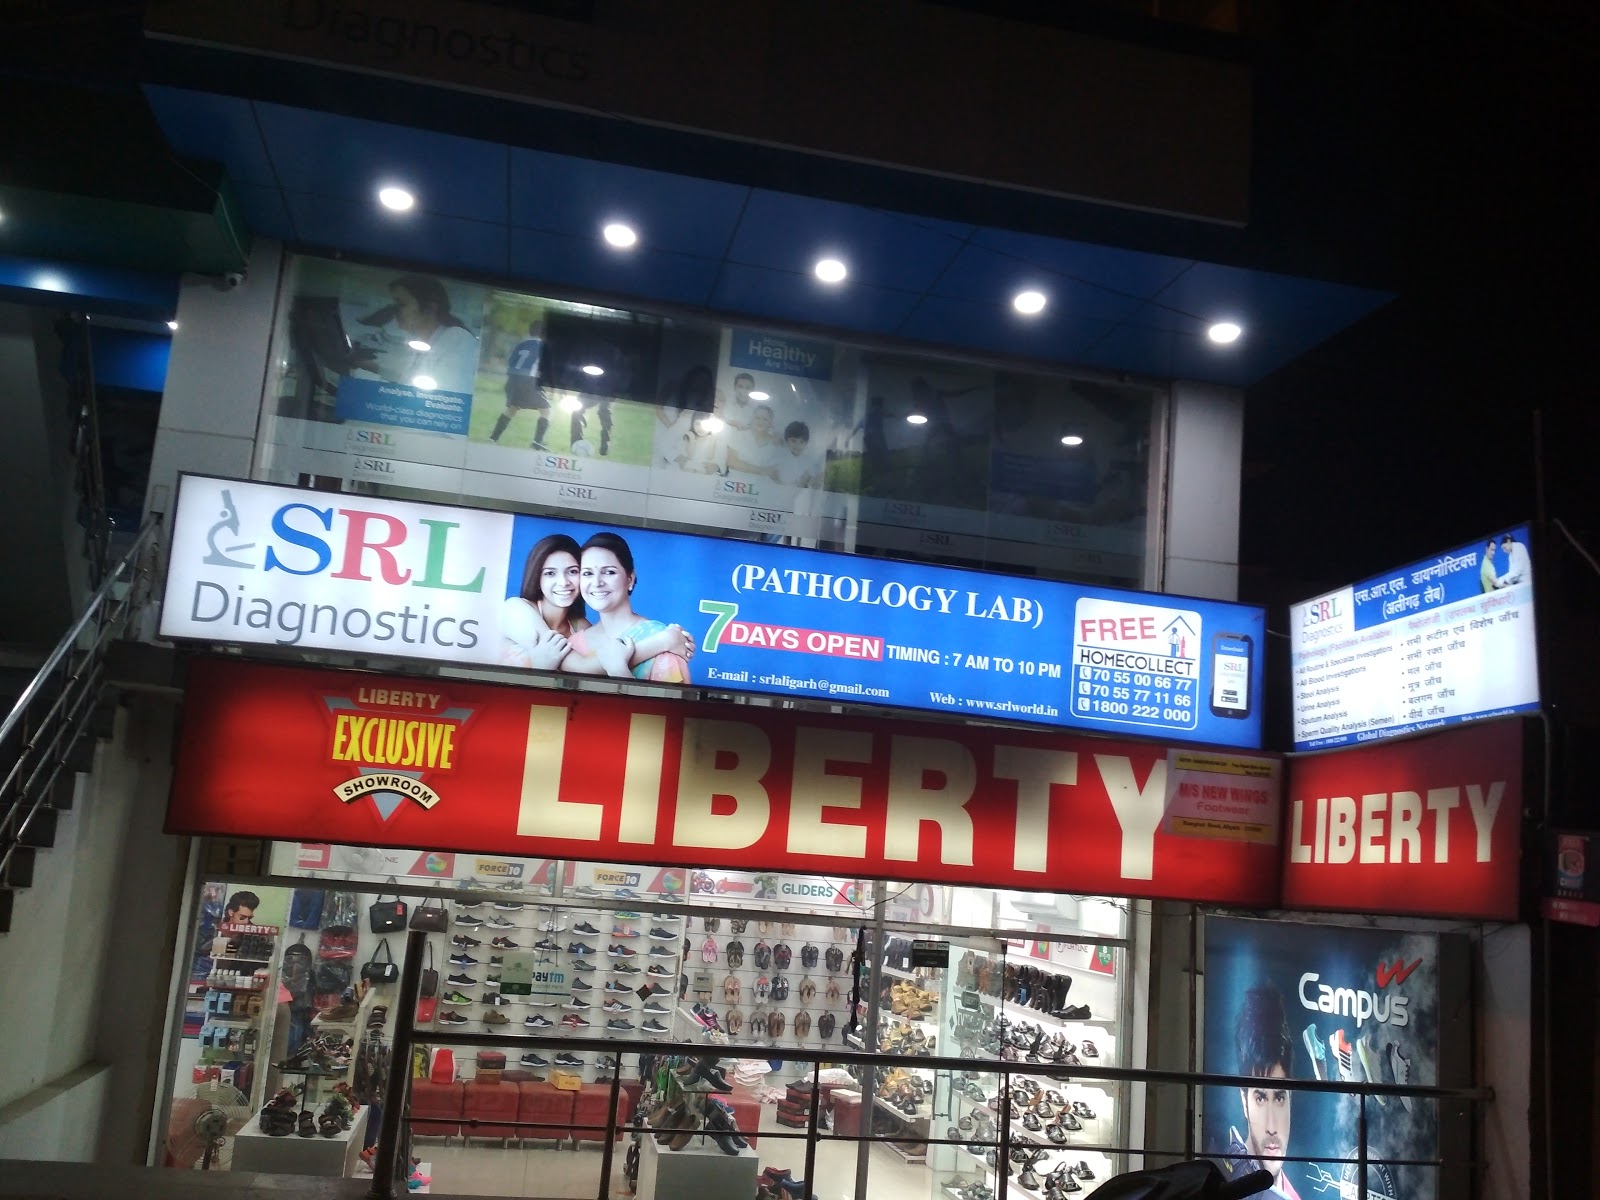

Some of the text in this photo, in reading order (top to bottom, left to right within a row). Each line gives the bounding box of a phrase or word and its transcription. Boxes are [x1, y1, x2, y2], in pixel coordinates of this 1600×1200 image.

[748, 340, 816, 367] Healthy
[356, 430, 396, 446] SRL
[364, 459, 395, 473] SRL
[545, 455, 582, 471] SRL
[567, 487, 597, 500] SRL
[723, 480, 759, 495] SRL
[264, 502, 487, 595] SRL
[731, 563, 1044, 629] (PATHOLOGY LAB)
[190, 580, 479, 649] Diagnostics
[1309, 597, 1342, 625] SRL
[699, 600, 880, 659] 7 DAYS OPEN
[1080, 617, 1157, 642] FREE
[886, 644, 940, 665] TIMING
[952, 653, 962, 667] 7
[965, 655, 989, 671] AM
[992, 658, 1014, 673] TO
[1017, 660, 1035, 676] 10
[1038, 662, 1061, 678] PM
[1080, 649, 1194, 676] HOMECOLLECT
[1223, 661, 1246, 673] SRL
[707, 667, 749, 683] E-mail
[759, 673, 890, 698] srlaligarh@gmail.com
[1093, 669, 1192, 692] 70 55 00 66 77
[358, 687, 441, 710] LIBERTY
[930, 691, 955, 706] Web
[966, 697, 1058, 718] www.srlworld.in
[1092, 684, 1191, 707] 70 55 77 11 66
[1092, 700, 1191, 722] 1800 222 000
[1341, 720, 1367, 731] Analysis
[332, 714, 456, 769] EXCLUSIVE
[343, 776, 433, 804] SHOWROOM
[516, 702, 1174, 882] LIBERTY
[1202, 785, 1228, 801] NEW
[1197, 801, 1250, 816] Footwear
[1291, 780, 1507, 864] LIBERTY
[781, 882, 833, 898] GLIDERS
[229, 924, 272, 935] LIBERTY
[1298, 972, 1410, 1028] Campus
